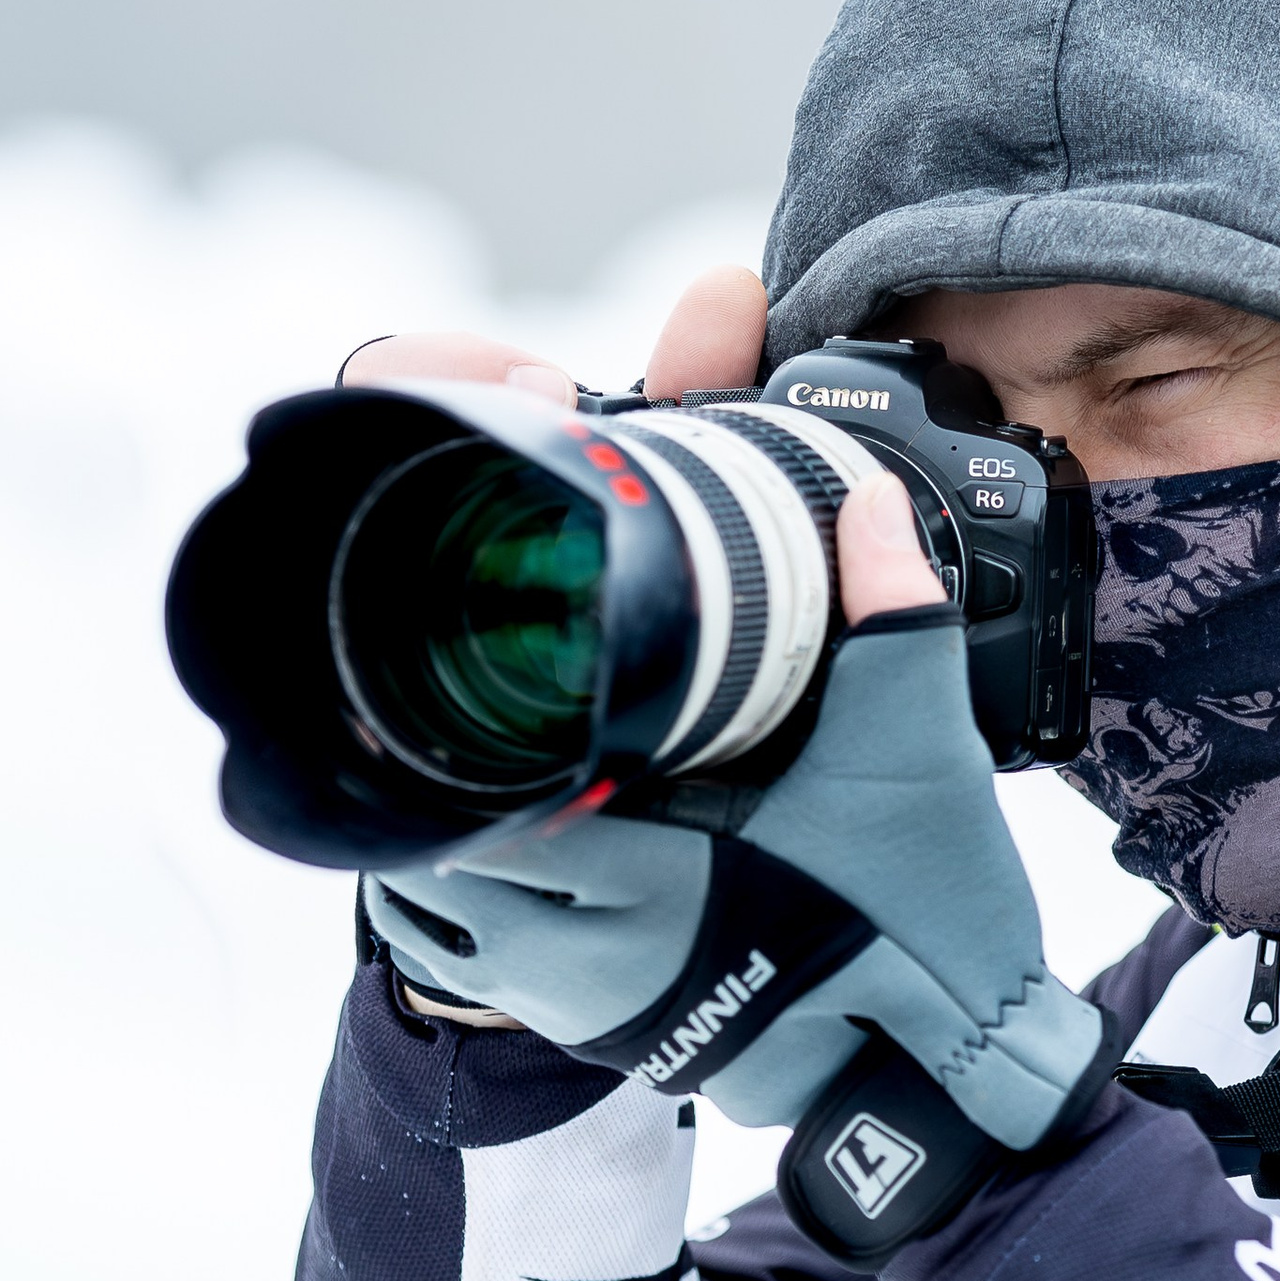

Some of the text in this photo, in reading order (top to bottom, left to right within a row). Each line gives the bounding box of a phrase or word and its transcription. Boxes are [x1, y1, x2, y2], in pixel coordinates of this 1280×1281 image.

[787, 382, 890, 411] Canon
[968, 457, 1016, 478] EOS
[975, 489, 1005, 509] R6
[627, 949, 777, 1087] FINNTRA
